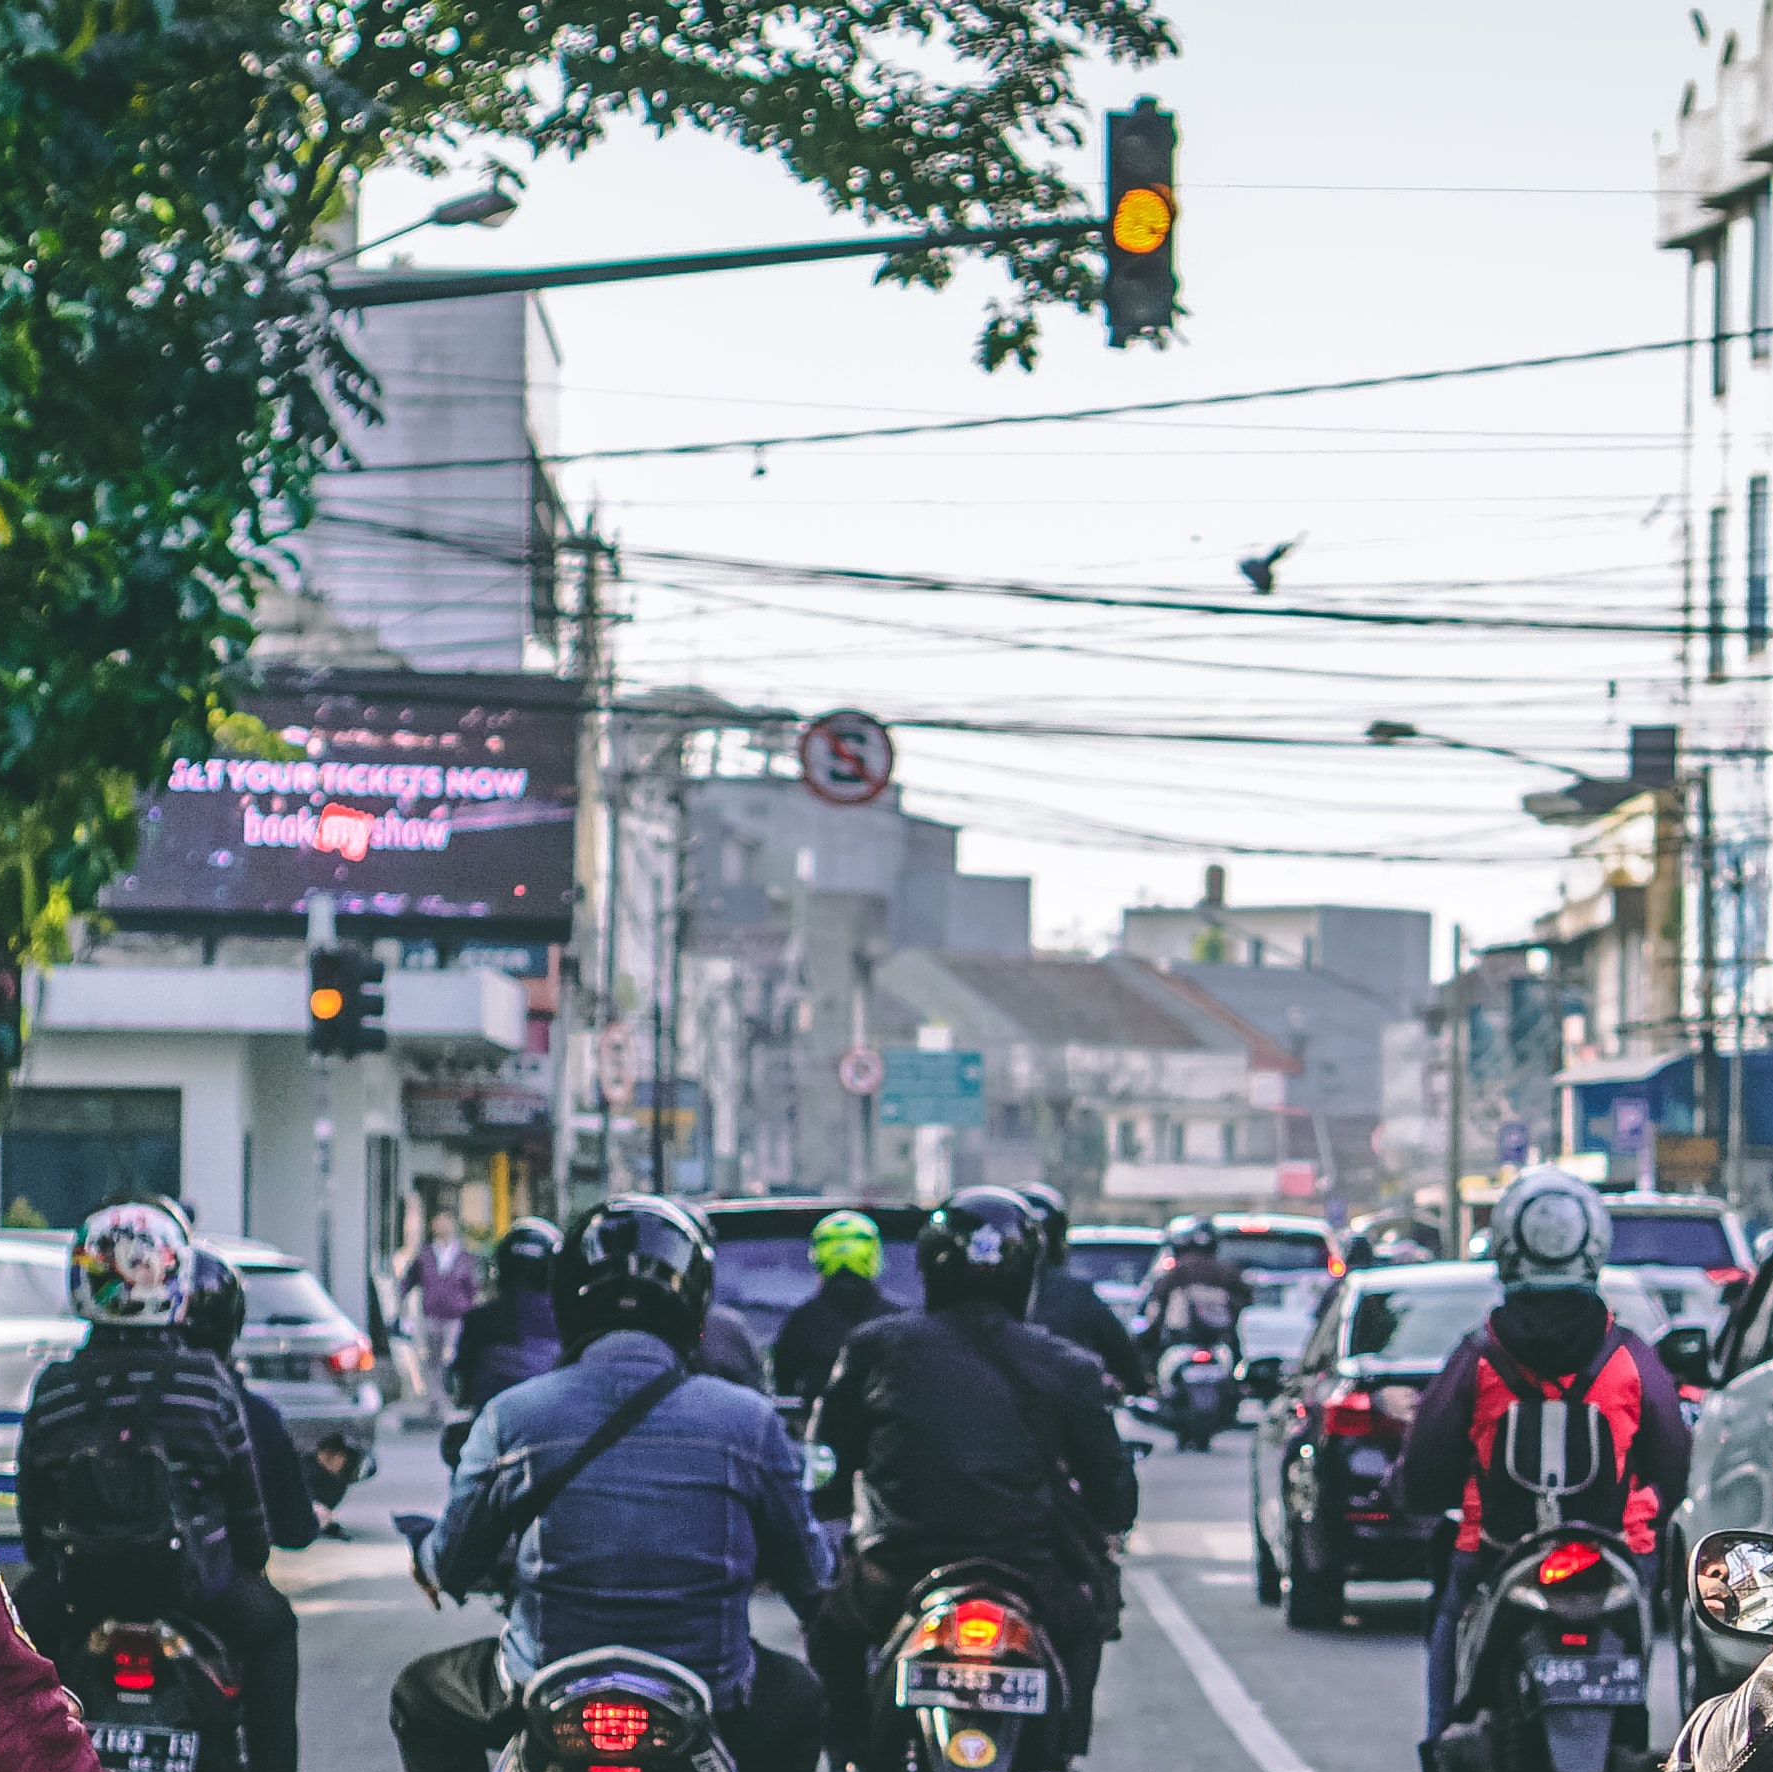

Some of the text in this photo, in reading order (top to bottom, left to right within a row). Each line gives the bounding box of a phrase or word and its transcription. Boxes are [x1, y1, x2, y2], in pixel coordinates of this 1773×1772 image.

[227, 759, 318, 793] YOUR
[320, 763, 442, 797] TICKETS
[444, 766, 529, 798] NOW
